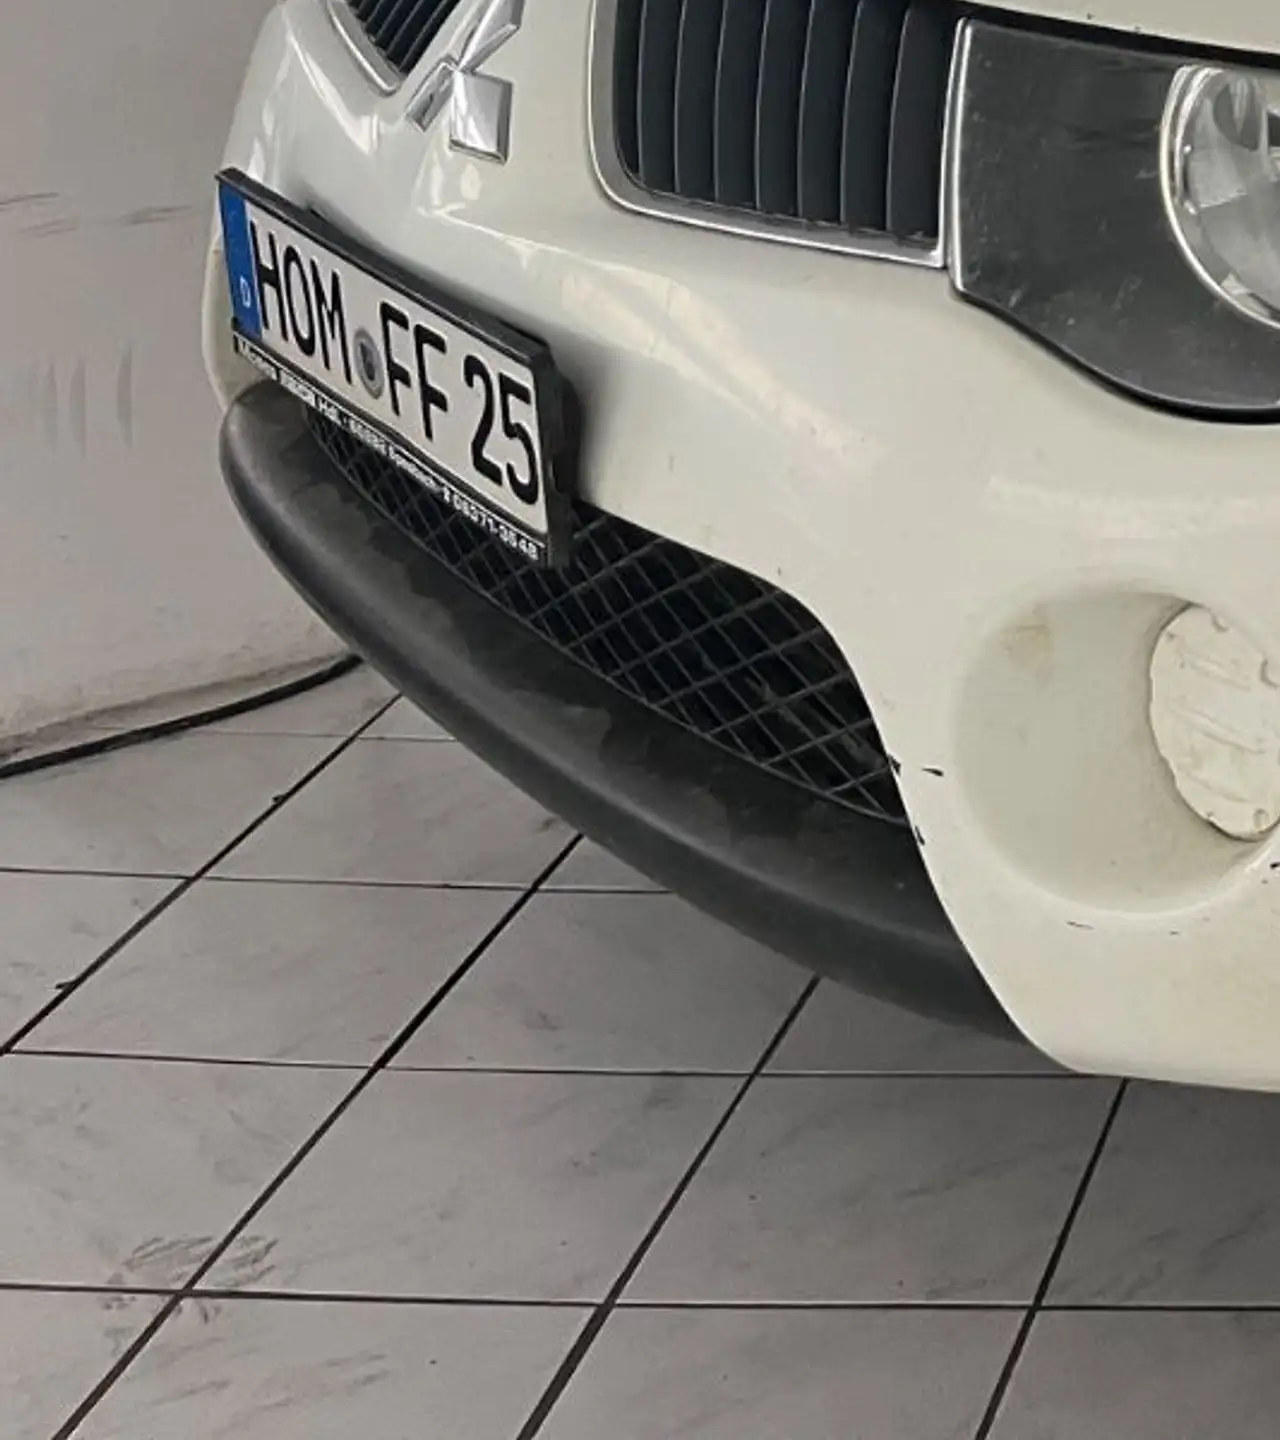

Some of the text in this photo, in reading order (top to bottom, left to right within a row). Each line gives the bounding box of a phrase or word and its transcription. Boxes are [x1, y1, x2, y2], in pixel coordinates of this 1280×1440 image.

[250, 219, 538, 505] HOM FF 25
